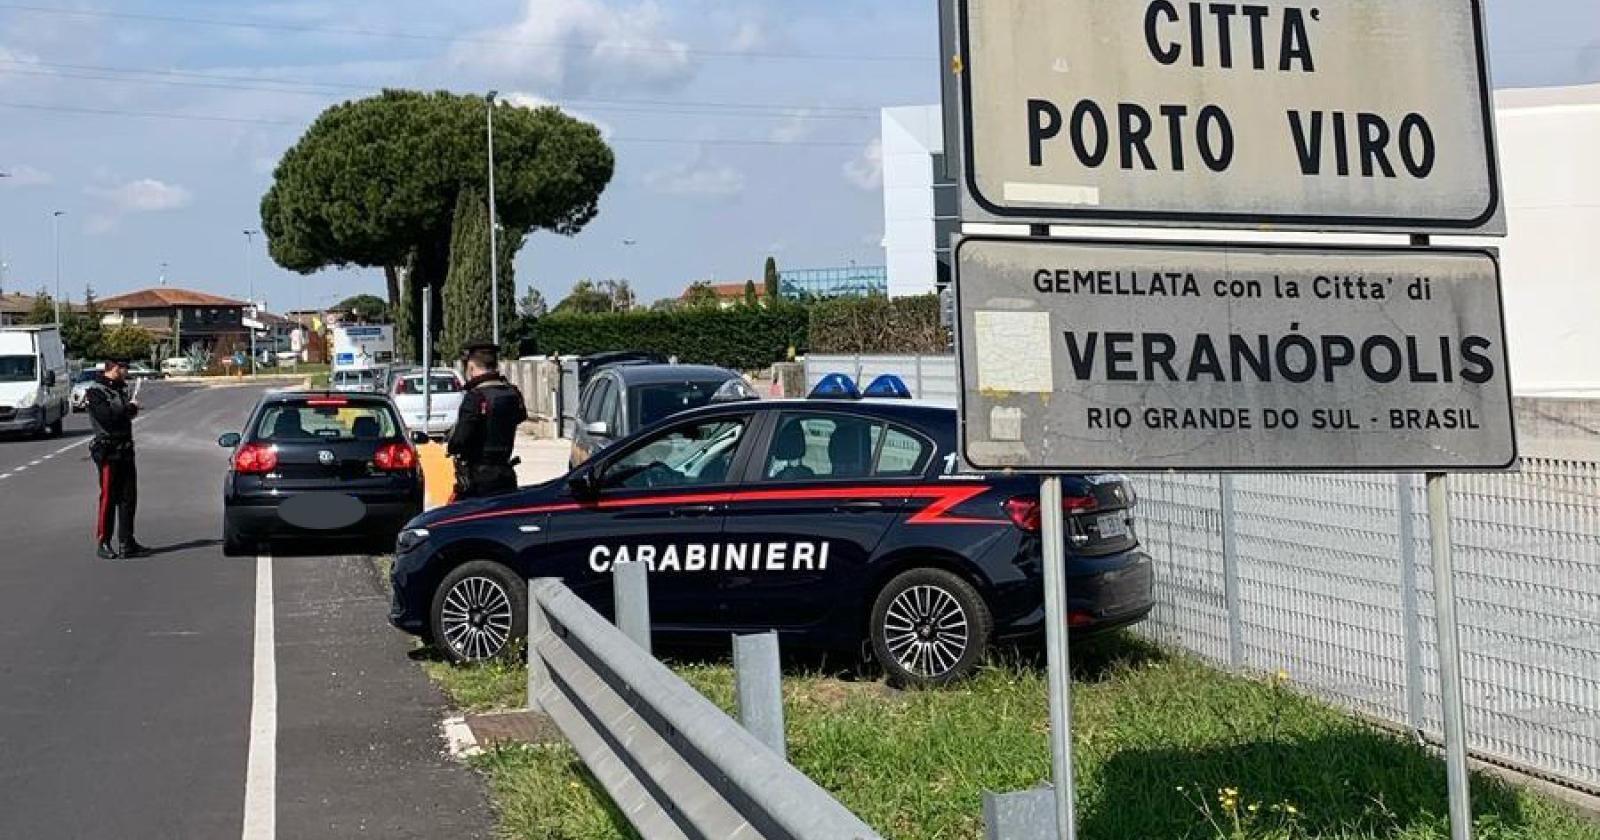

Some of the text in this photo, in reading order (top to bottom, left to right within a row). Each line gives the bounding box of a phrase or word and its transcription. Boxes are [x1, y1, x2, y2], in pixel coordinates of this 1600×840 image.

[1027, 99, 1436, 179] PORTO VIRO
[1033, 269, 1432, 301] GEMELLATA con la Citta' di
[1064, 322, 1494, 384] VERANÓPOLIS
[1087, 407, 1132, 430] RIO
[1143, 407, 1252, 430] GRANDE
[1262, 408, 1300, 431] DO
[1311, 408, 1360, 431] SUL
[1389, 408, 1480, 430] BRASIL
[589, 541, 830, 573] CARABINIERI
